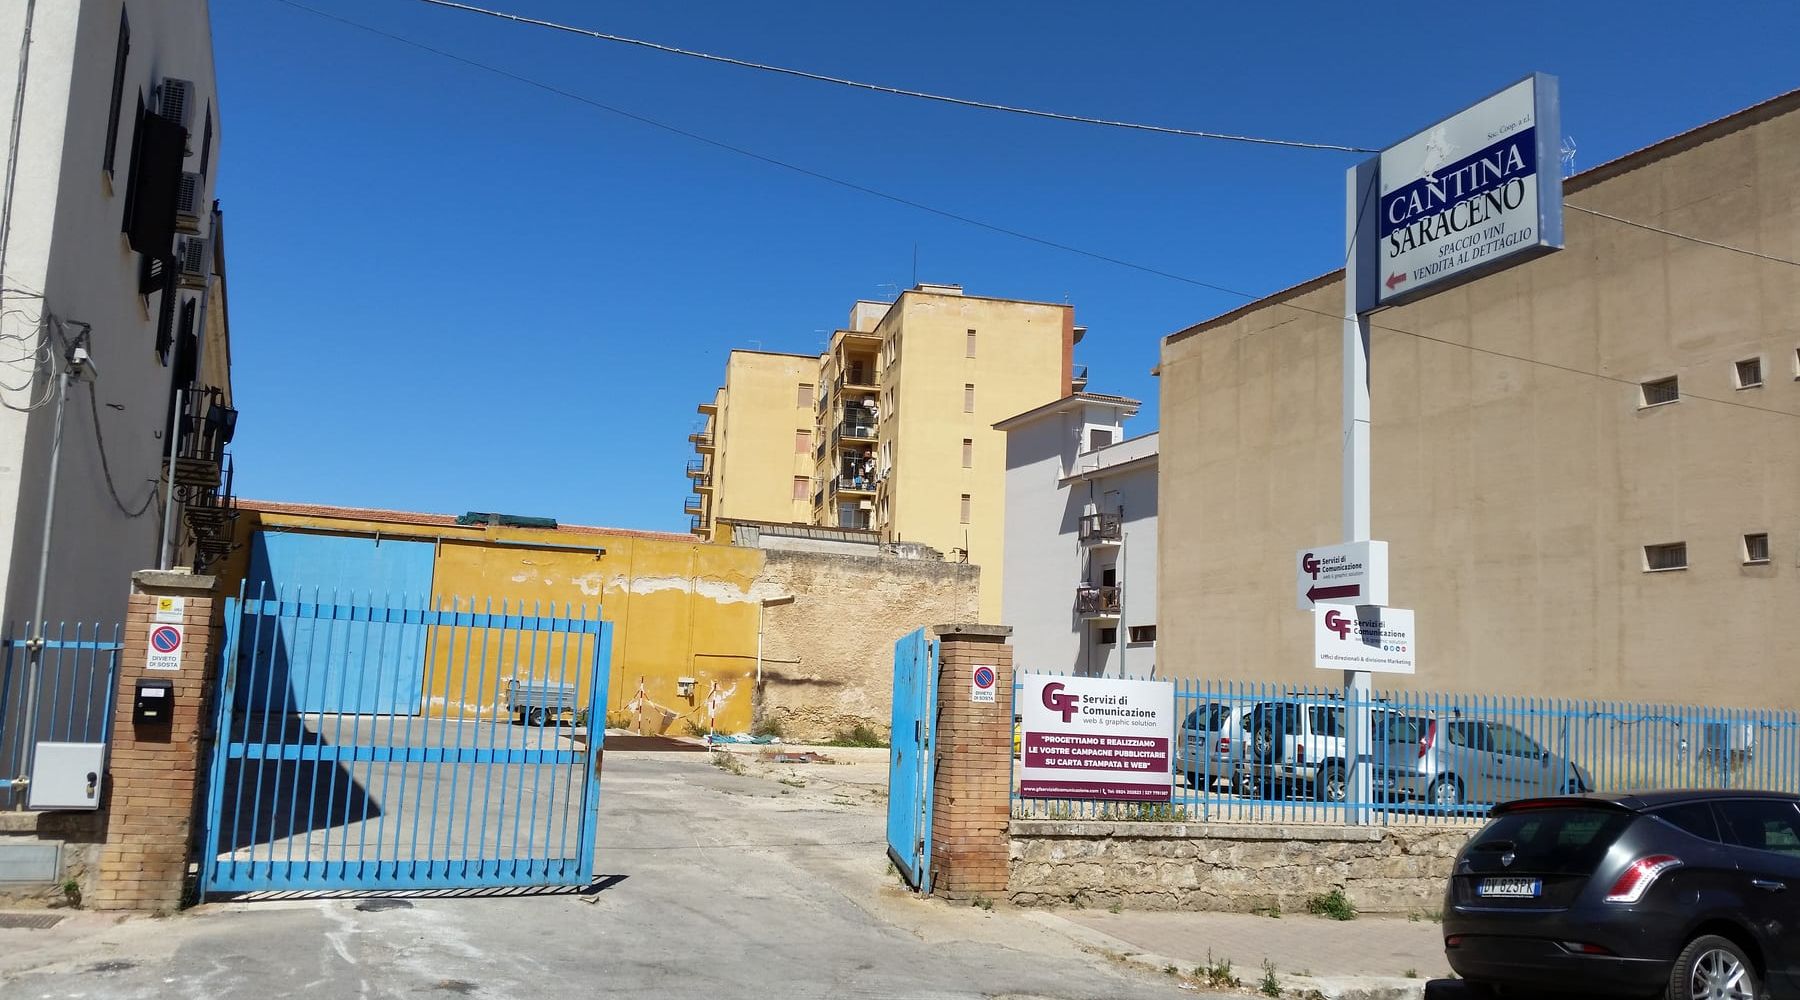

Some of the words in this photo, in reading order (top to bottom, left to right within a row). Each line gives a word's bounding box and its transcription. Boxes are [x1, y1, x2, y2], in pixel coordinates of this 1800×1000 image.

[1388, 144, 1526, 224] CANTINA
[1390, 176, 1525, 258] SARACENO
[1438, 231, 1481, 259] SPACCIO
[1483, 222, 1506, 242] VINI
[1412, 257, 1455, 281] VENDITA
[1456, 251, 1470, 266] AL
[1471, 227, 1532, 262] DETTAGLIO
[1303, 553, 1321, 580] GF
[1322, 557, 1340, 565] Servizi
[1341, 555, 1346, 563] di
[1322, 563, 1362, 573] Comunicazione
[1325, 610, 1351, 640] GF
[1353, 620, 1378, 628] Servizi
[1353, 628, 1405, 638] Comunicazione
[1320, 653, 1334, 661] Uffici
[1334, 654, 1361, 662] direzionali
[1365, 656, 1387, 664] divisione
[1387, 658, 1411, 667] Marketing
[1042, 682, 1079, 723] GF
[1082, 694, 1116, 705] Servizi
[1118, 696, 1128, 705] di
[1082, 706, 1156, 718] Comunicazione
[1105, 719, 1130, 727] graphic
[1041, 736, 1099, 745] "PROGETTIAMO
[1107, 738, 1155, 747] REALIZZIAMO
[1028, 746, 1038, 754] LE
[1040, 747, 1070, 755] VOSTRE
[1071, 748, 1112, 757] CAMPAGNE
[1114, 750, 1166, 759] PUBBLICITARIE
[1045, 758, 1056, 766] SU
[1057, 759, 1082, 767] CARTA
[1084, 760, 1122, 768] STAMPATA
[1131, 761, 1151, 769] WEB"
[1484, 878, 1497, 893] DV
[1500, 879, 1533, 893] 823PK
